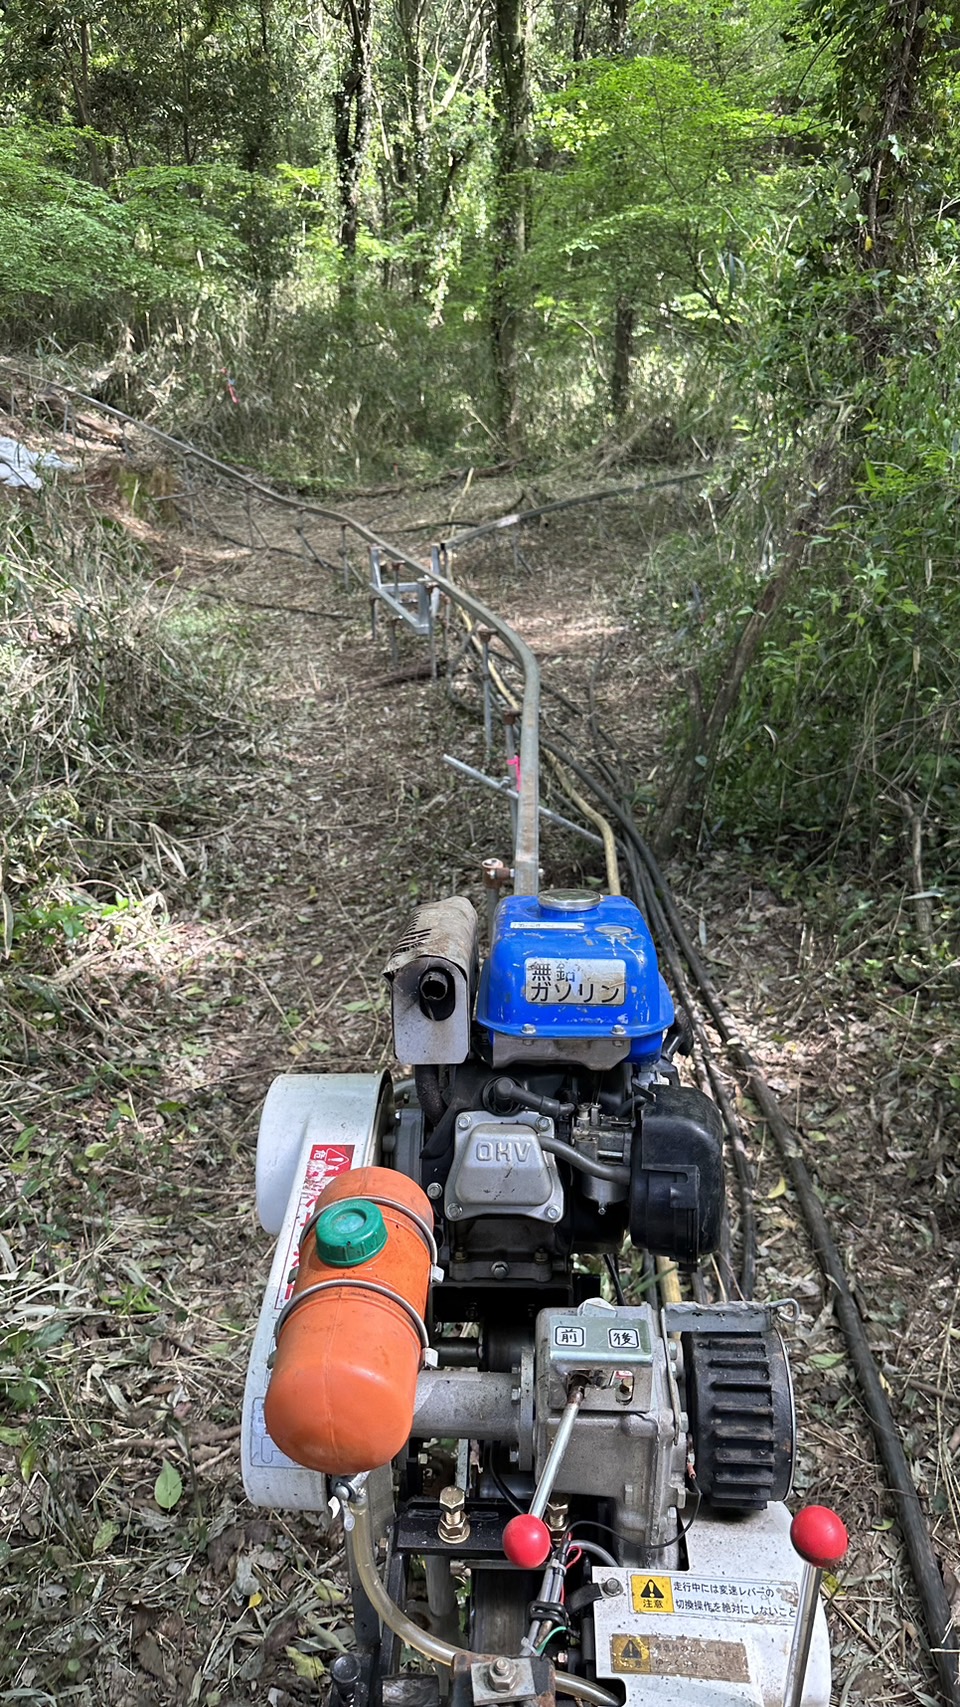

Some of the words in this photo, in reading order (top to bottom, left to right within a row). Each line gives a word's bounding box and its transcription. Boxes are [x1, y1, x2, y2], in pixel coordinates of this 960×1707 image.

[529, 962, 575, 982] 無鉛
[531, 982, 619, 1003] ガソリン
[476, 1142, 532, 1163] OHV
[560, 1328, 578, 1344] 前
[613, 1331, 636, 1347] 後
[673, 1581, 775, 1598] 走行中には変速レバーの
[642, 1598, 664, 1609] 注意
[675, 1599, 797, 1618] 切換操作を絶対にしないこと
